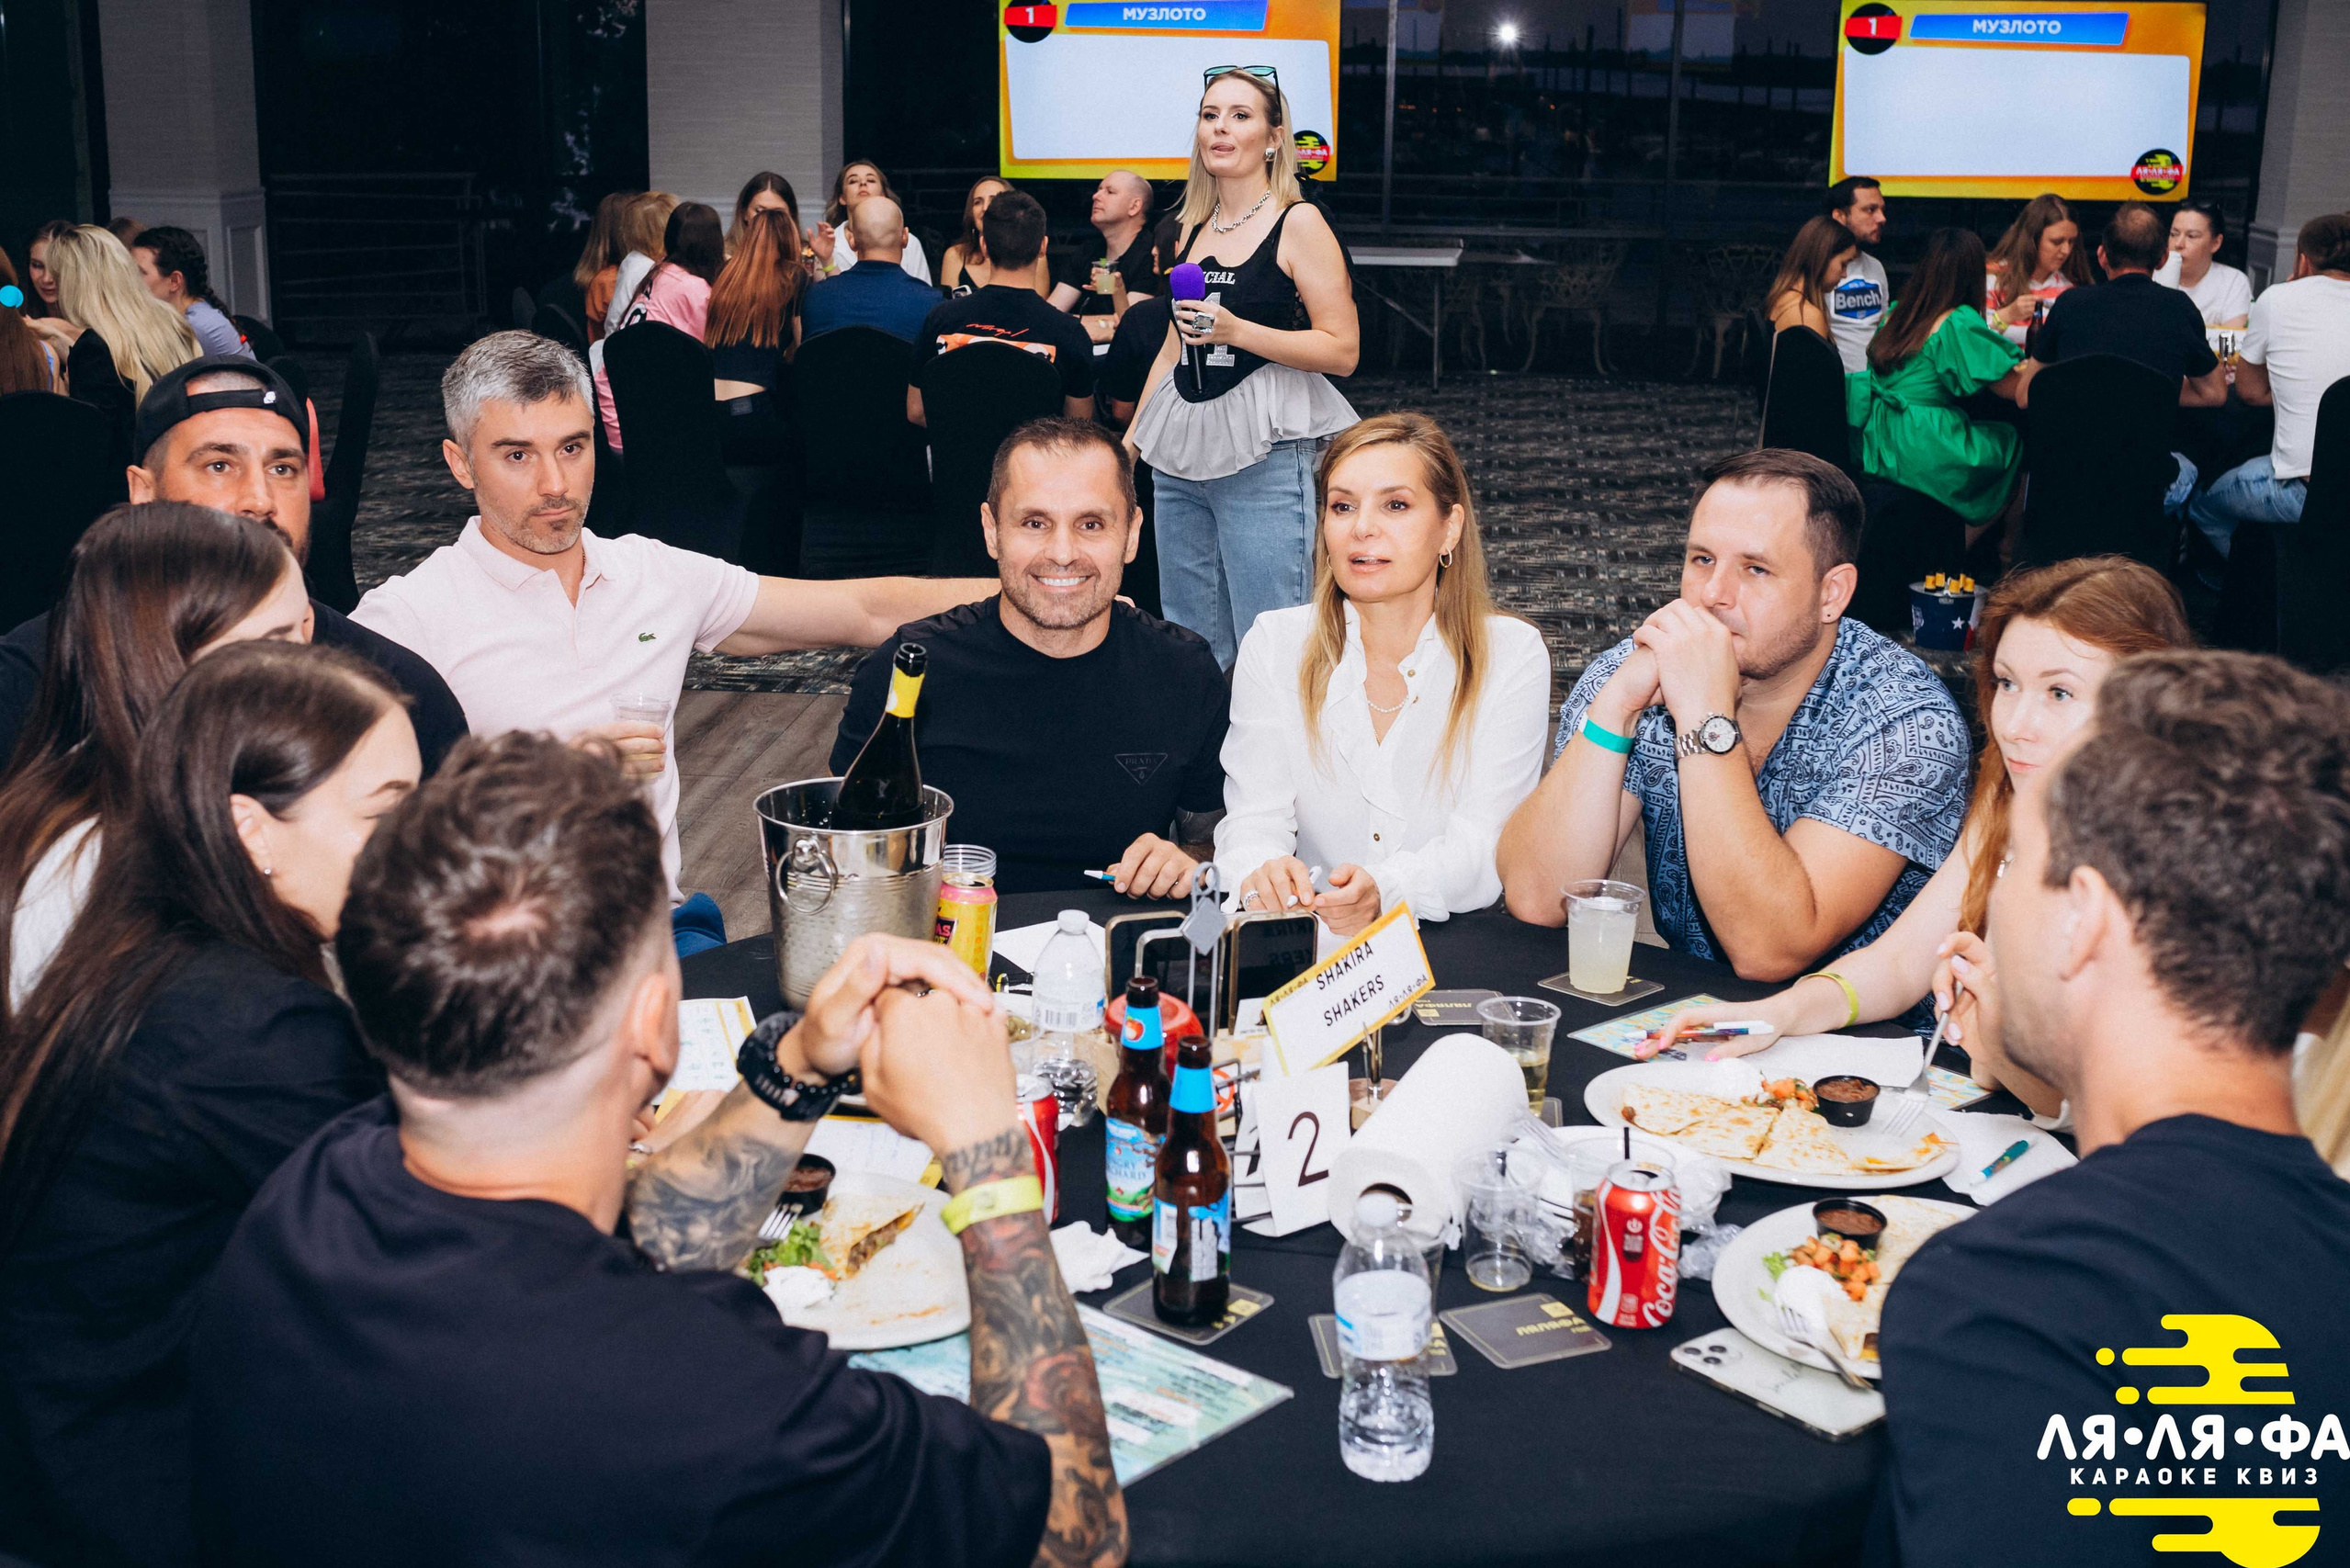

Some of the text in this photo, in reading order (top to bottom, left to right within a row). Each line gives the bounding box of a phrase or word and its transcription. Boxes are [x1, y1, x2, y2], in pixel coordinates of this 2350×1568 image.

[1024, 6, 1035, 24] 1
[1123, 7, 1206, 22] МУЗЛОТО
[1867, 17, 1878, 36] 1
[1972, 18, 2062, 35] МУЗЛОТО
[1836, 290, 1881, 310] Bench
[1316, 941, 1374, 990] SHAKIRA
[1323, 975, 1384, 1027] SHAKERS
[1287, 1111, 1329, 1188] 2
